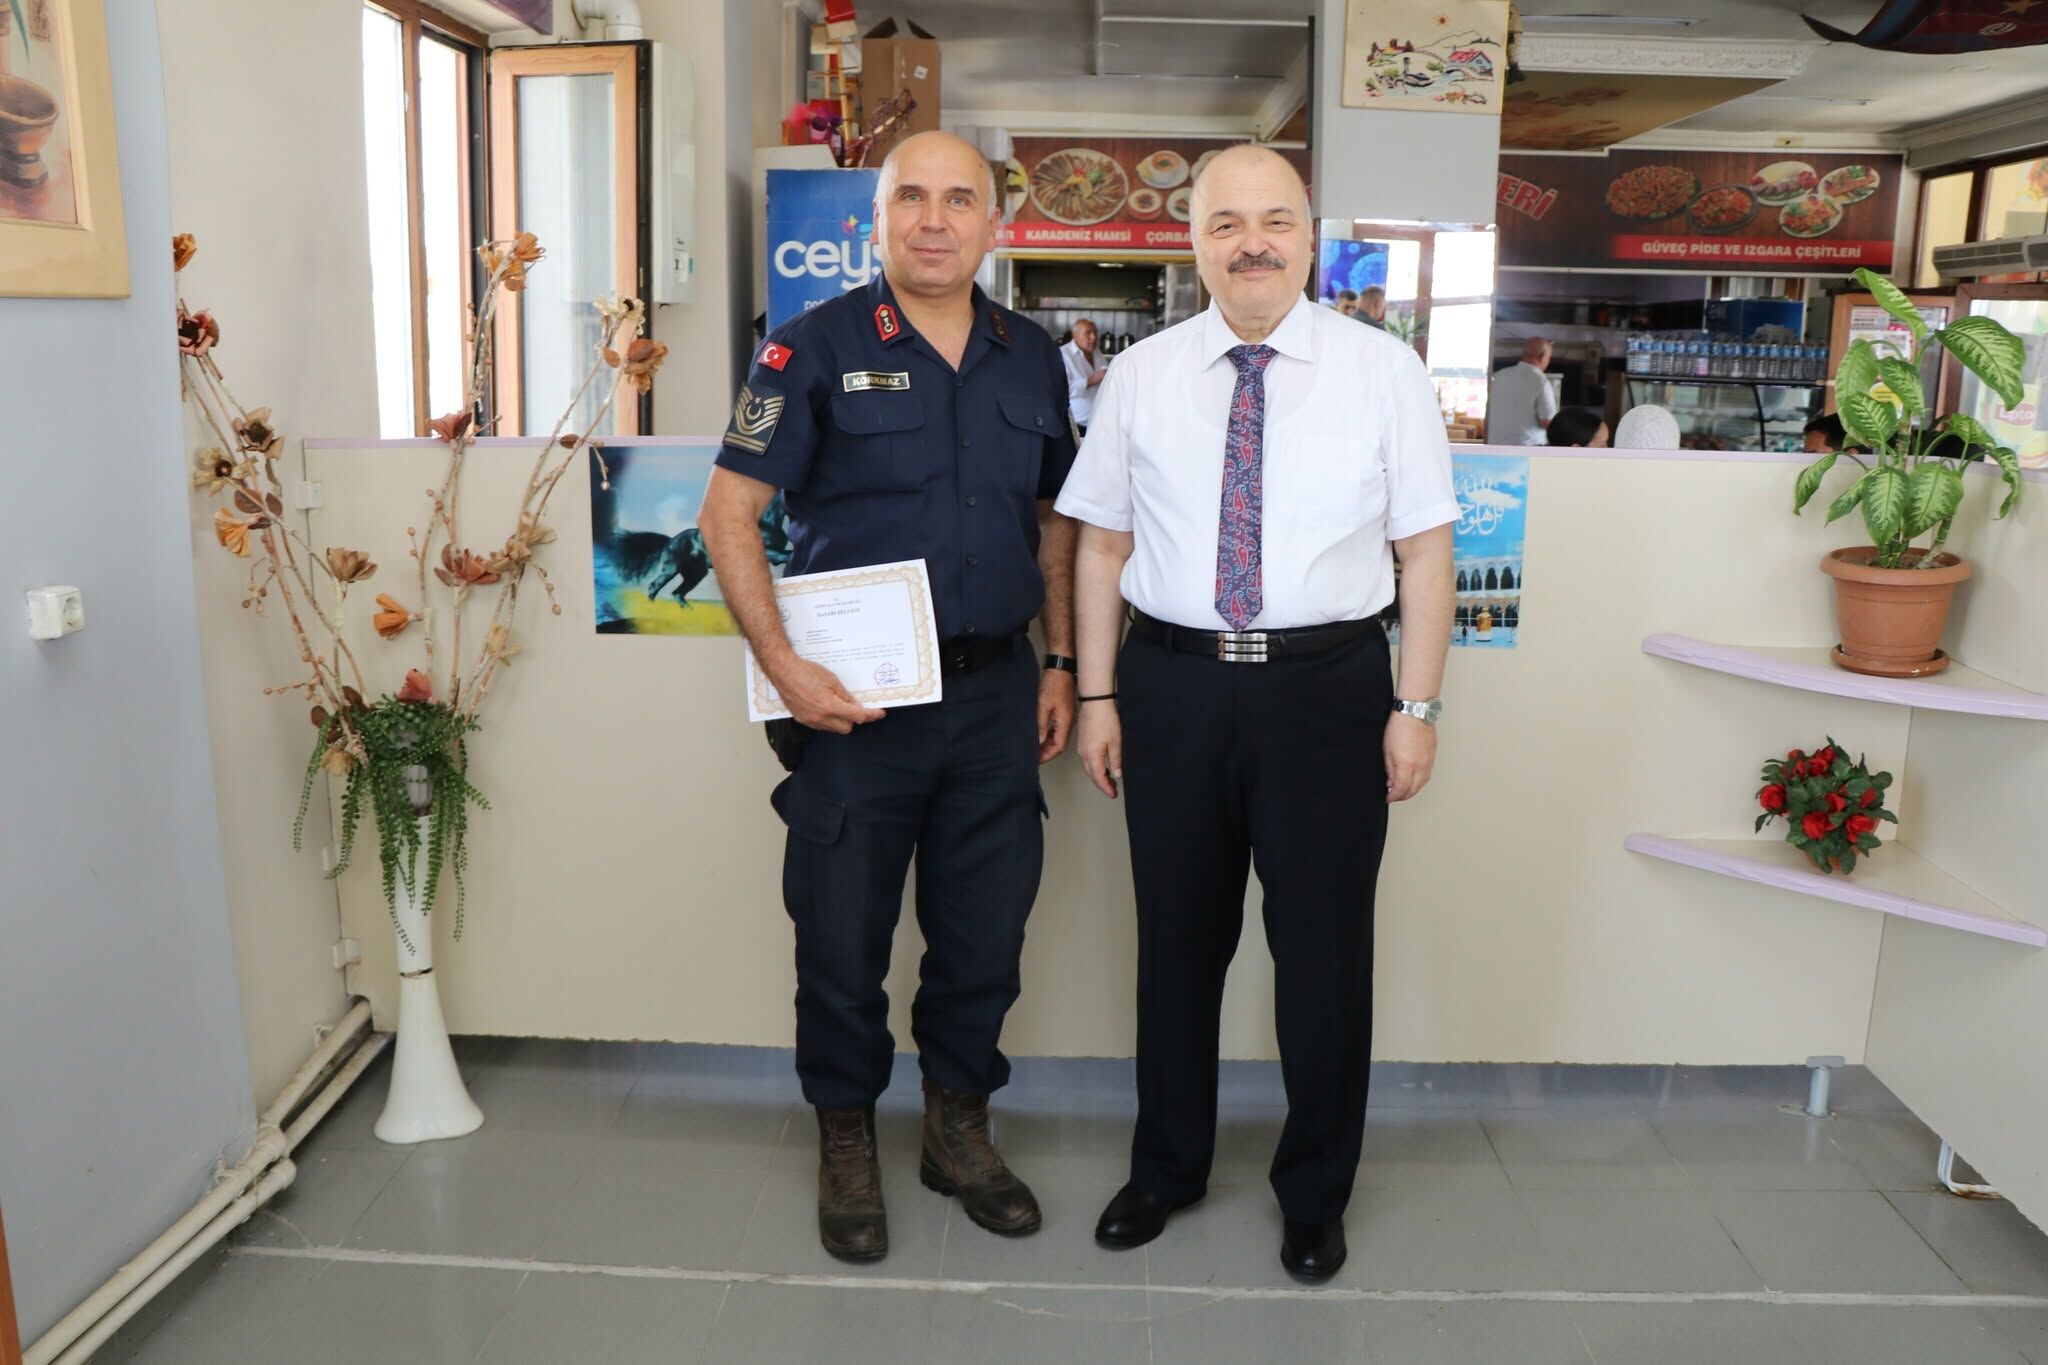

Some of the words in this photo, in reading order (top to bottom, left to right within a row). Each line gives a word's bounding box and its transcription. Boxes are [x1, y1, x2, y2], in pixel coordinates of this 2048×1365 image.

[1642, 240, 1686, 256] GÜVEÇ
[1691, 242, 1720, 255] PİDE
[1724, 244, 1741, 256] VE
[1744, 245, 1792, 257] IZGARA
[1795, 244, 1862, 259] ÇEŞİTLERİ
[852, 376, 901, 387] KORKMAZ
